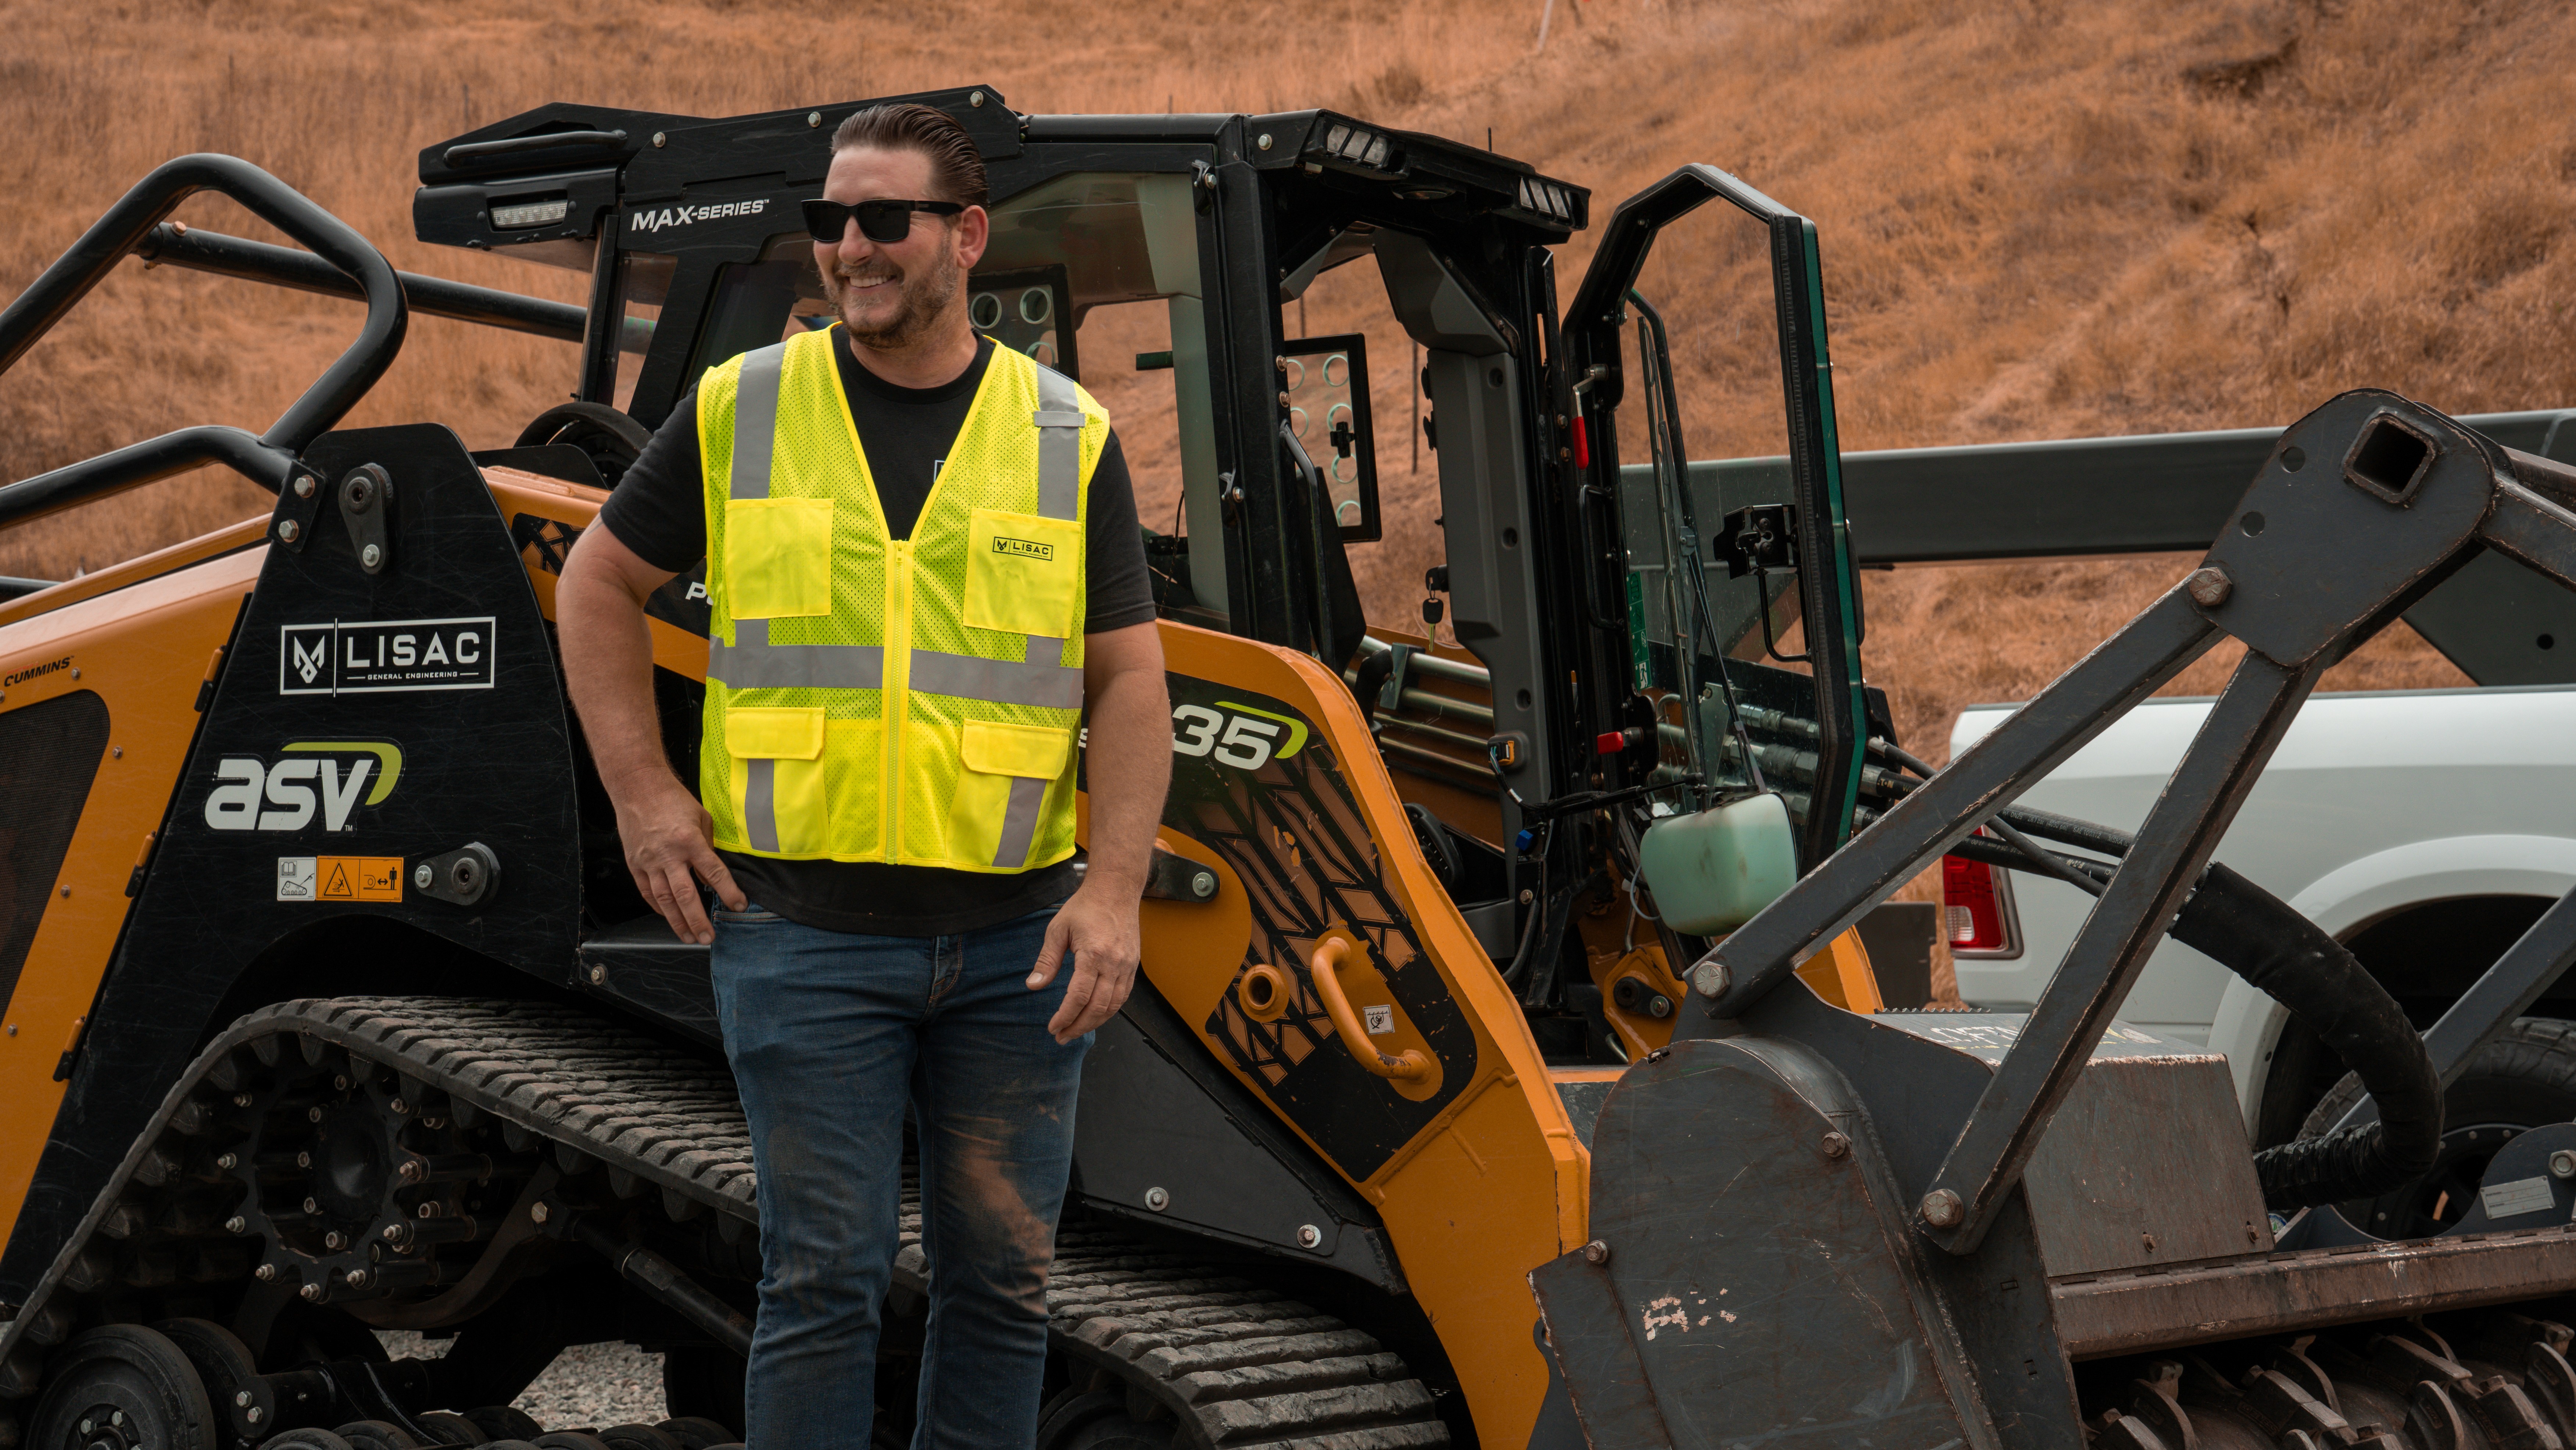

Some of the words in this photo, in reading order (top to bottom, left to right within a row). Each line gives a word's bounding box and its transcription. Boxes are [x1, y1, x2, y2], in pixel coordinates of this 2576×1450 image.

[1013, 542, 1049, 555] LISAC
[347, 632, 479, 668] LISAC
[2010, 811, 2023, 820] DN25
